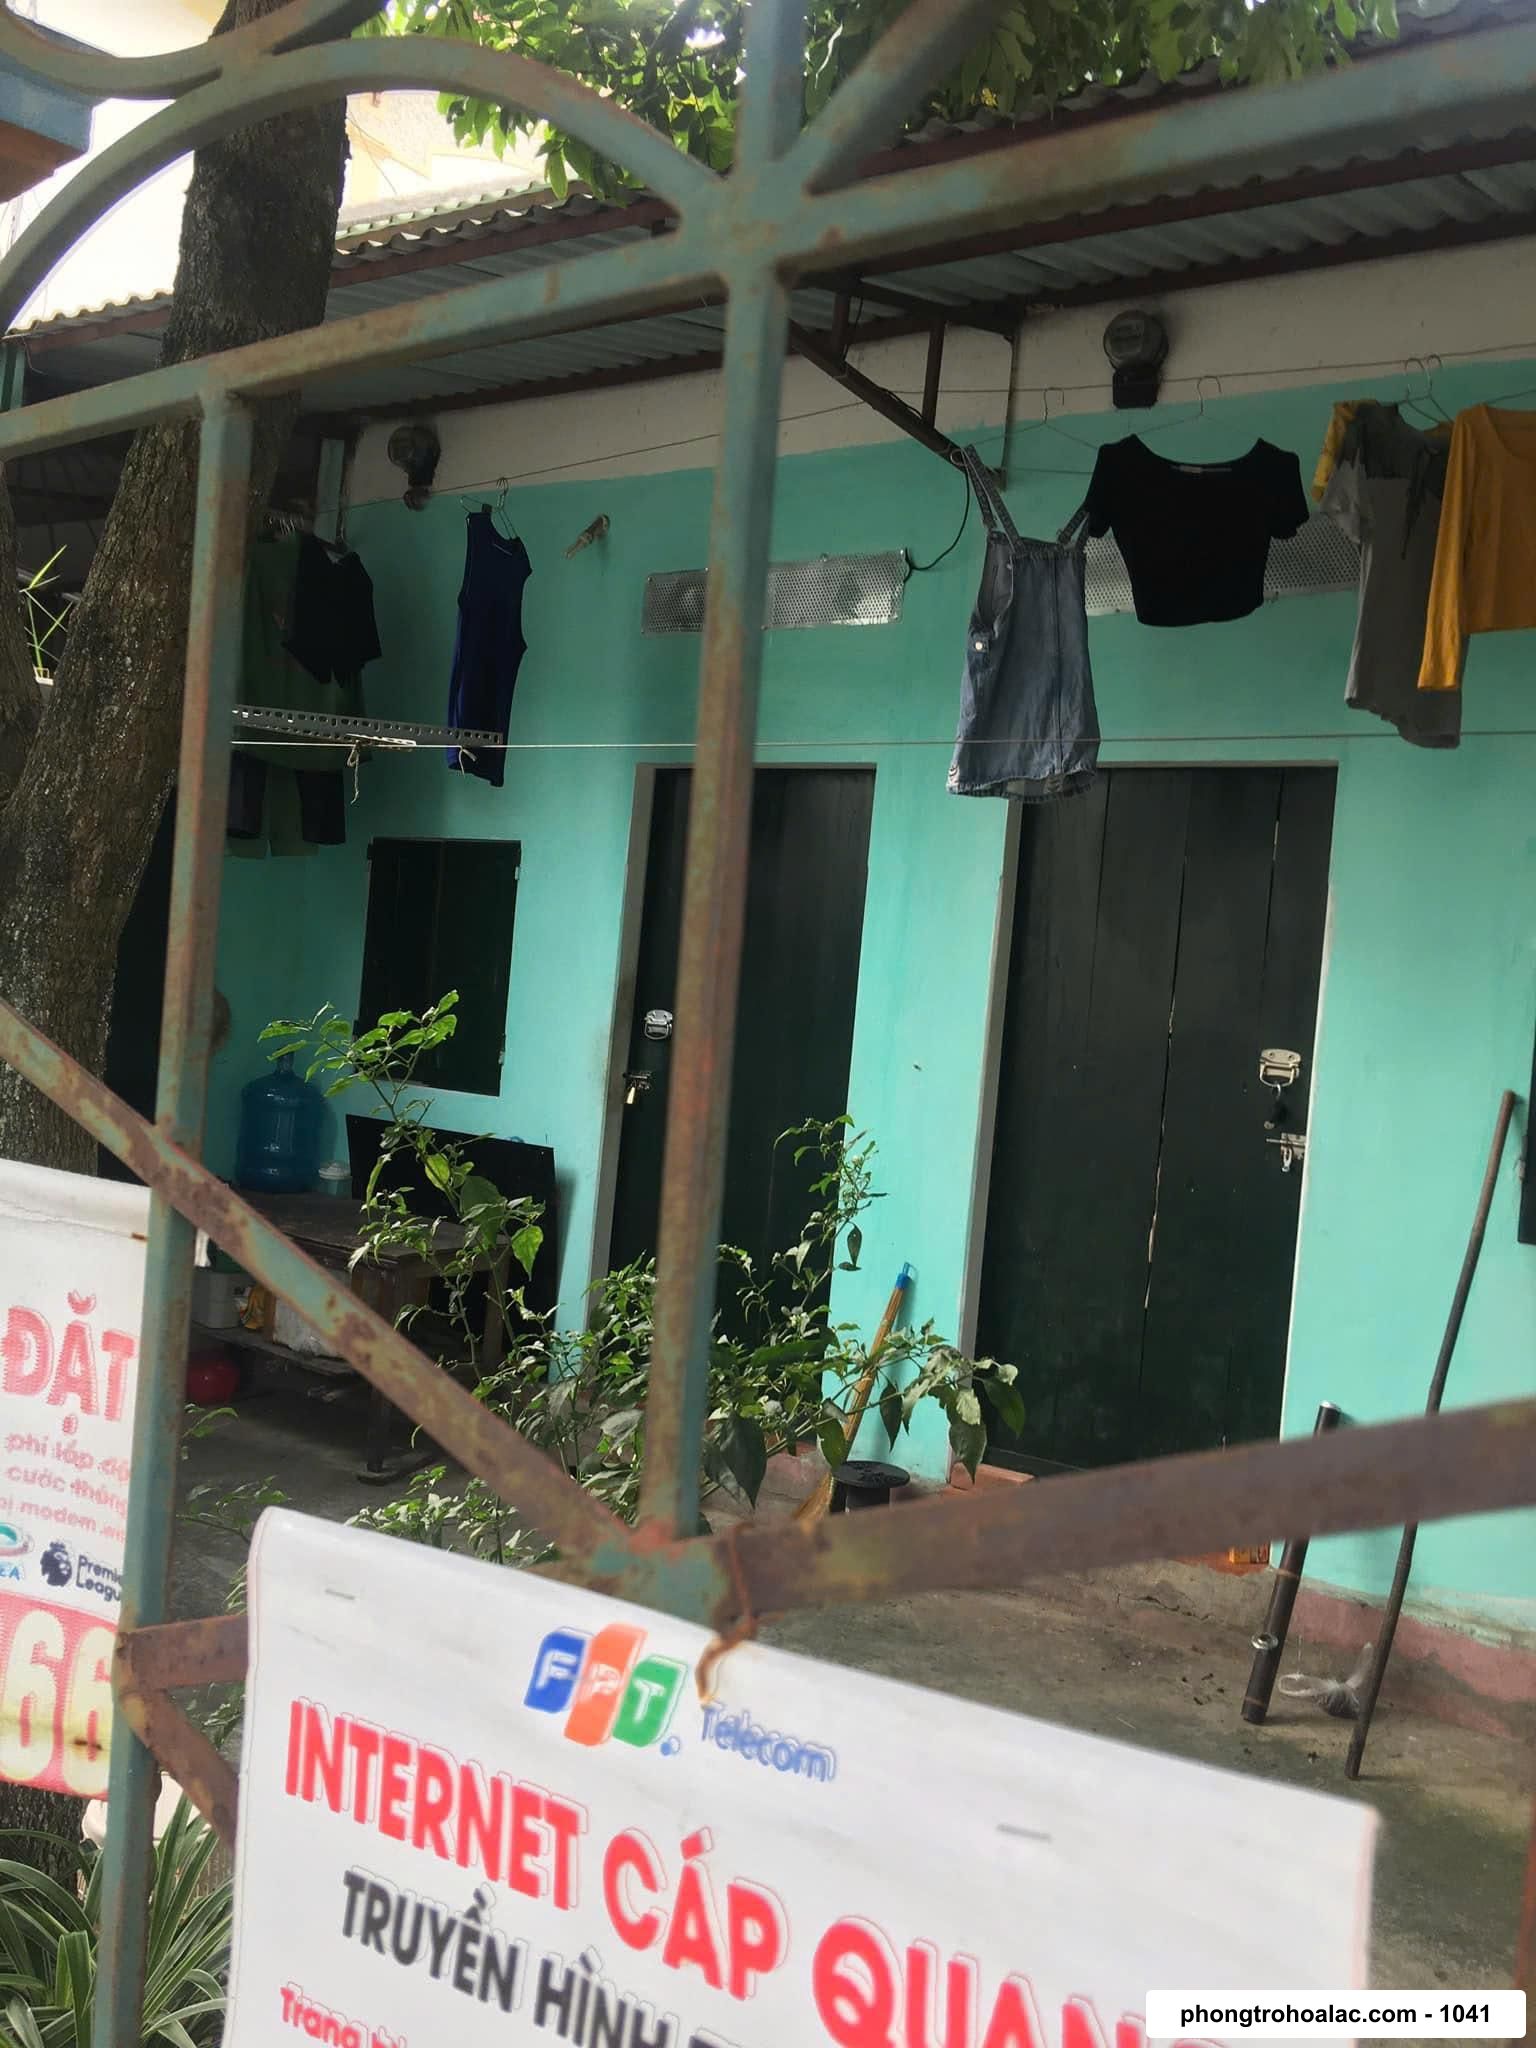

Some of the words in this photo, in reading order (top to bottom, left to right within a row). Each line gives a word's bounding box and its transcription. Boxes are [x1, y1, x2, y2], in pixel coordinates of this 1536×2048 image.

[1, 1288, 137, 1435] ĐẶT
[76, 1578, 122, 1602] Leagu
[534, 1646, 670, 1728] FPT
[702, 1701, 836, 1783] Telecom
[285, 1697, 587, 1911] INTERNET
[603, 1827, 788, 2001] CÁP
[811, 1914, 1225, 2048] QUA
[341, 1867, 526, 2014] TRUYỀN
[534, 1945, 680, 2048] HÌNH
